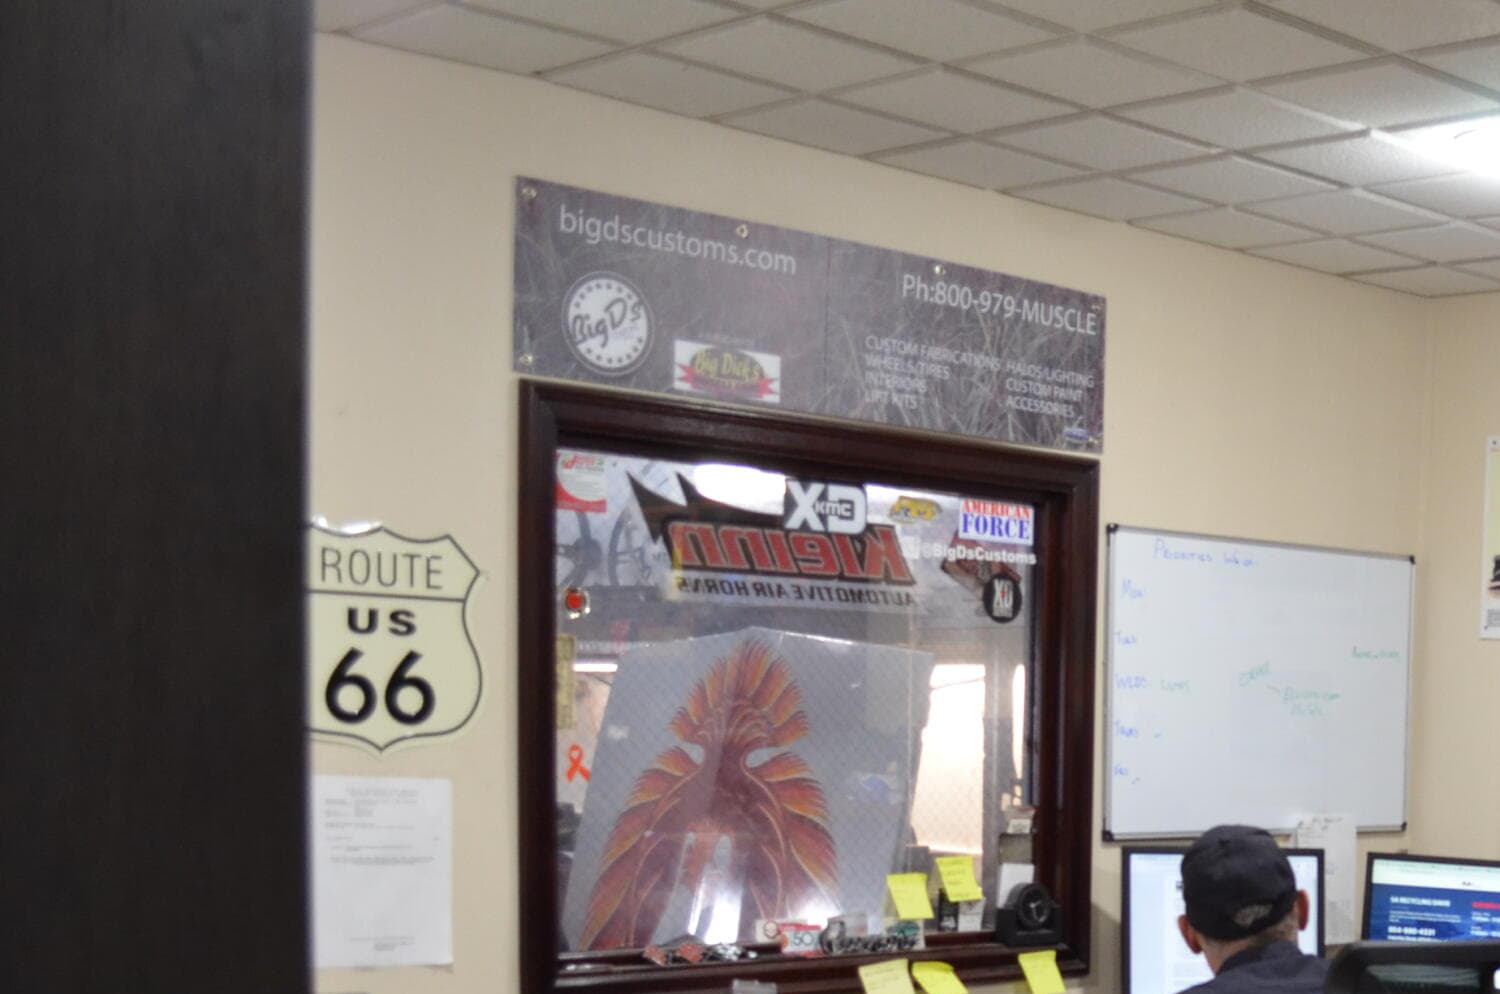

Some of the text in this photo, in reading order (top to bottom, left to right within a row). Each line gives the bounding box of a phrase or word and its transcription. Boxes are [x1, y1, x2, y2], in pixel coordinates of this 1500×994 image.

[559, 203, 797, 275] bigdscustoms.com
[865, 335, 1000, 371] CUSTOM FABRICATIONS
[1006, 378, 1084, 404] CUSTOM PAINT
[1006, 395, 1076, 419] ACCESSORIES
[962, 499, 1030, 519] AMERICAN
[962, 512, 1030, 539] FORCE
[320, 546, 444, 591] ROUTE
[346, 606, 418, 637] US
[324, 646, 437, 726] 66
